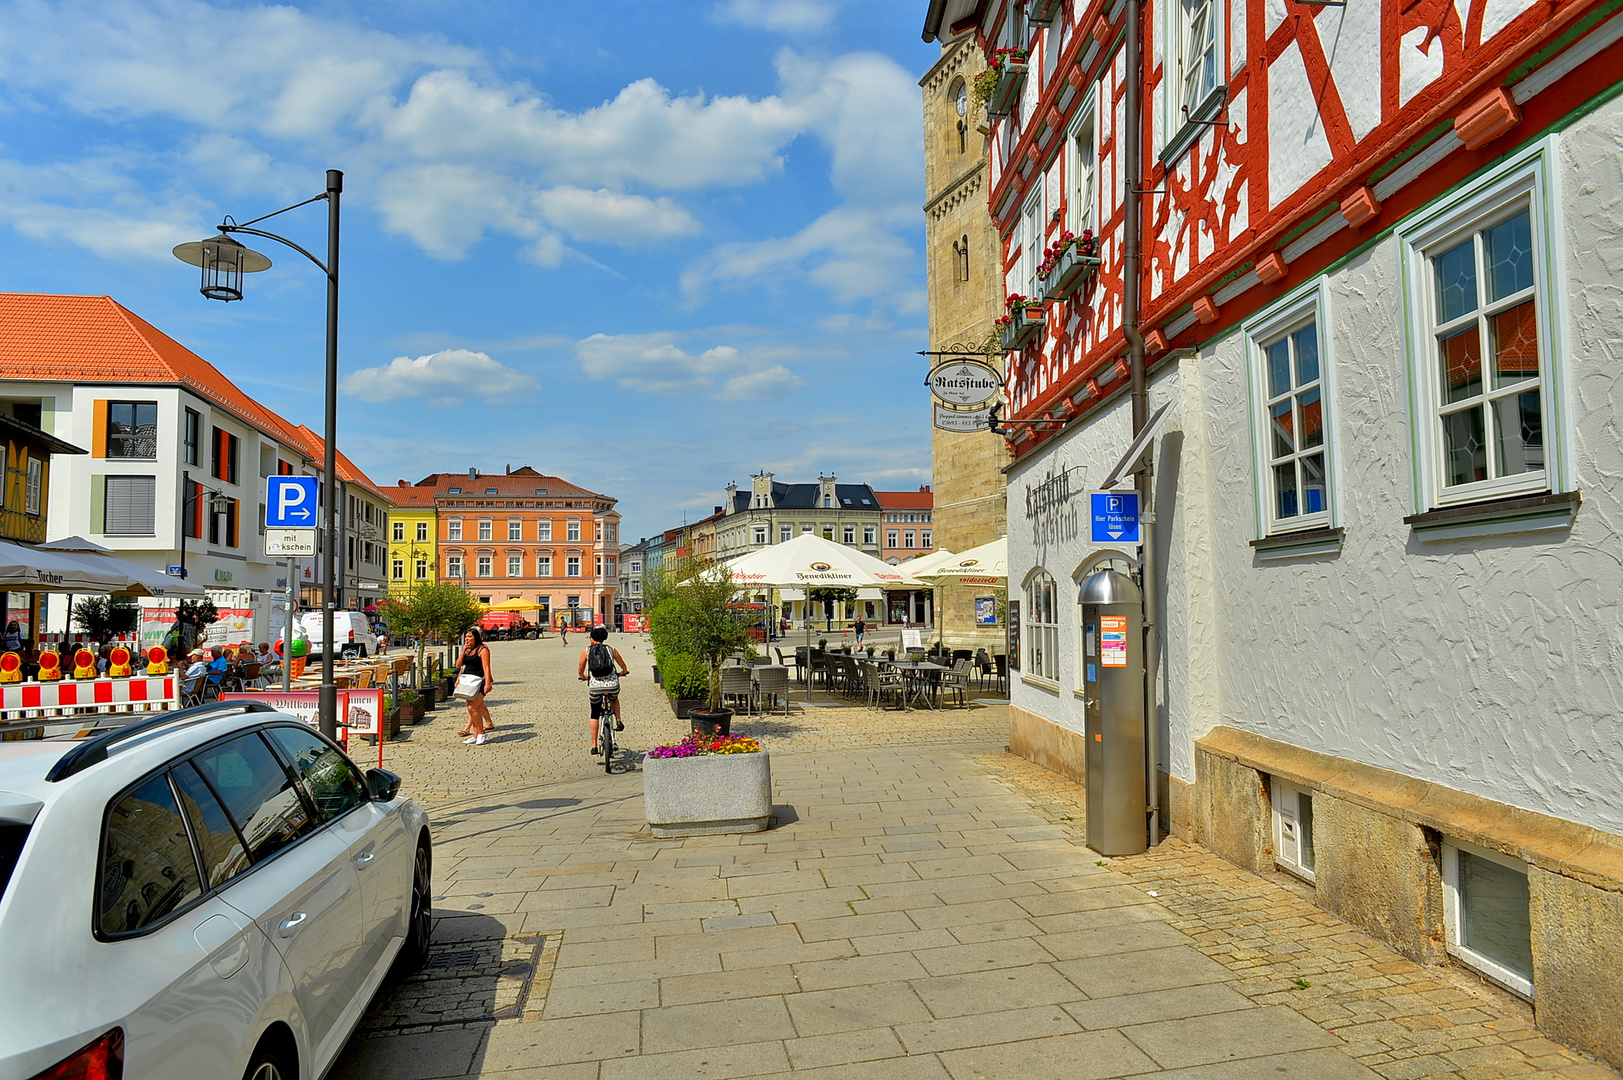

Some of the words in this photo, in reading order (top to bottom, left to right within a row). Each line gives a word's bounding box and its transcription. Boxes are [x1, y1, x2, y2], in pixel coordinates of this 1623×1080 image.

[278, 483, 306, 520] P
[1110, 498, 1119, 511] P
[36, 569, 63, 584] Tucher
[795, 572, 852, 580] Benediktiner
